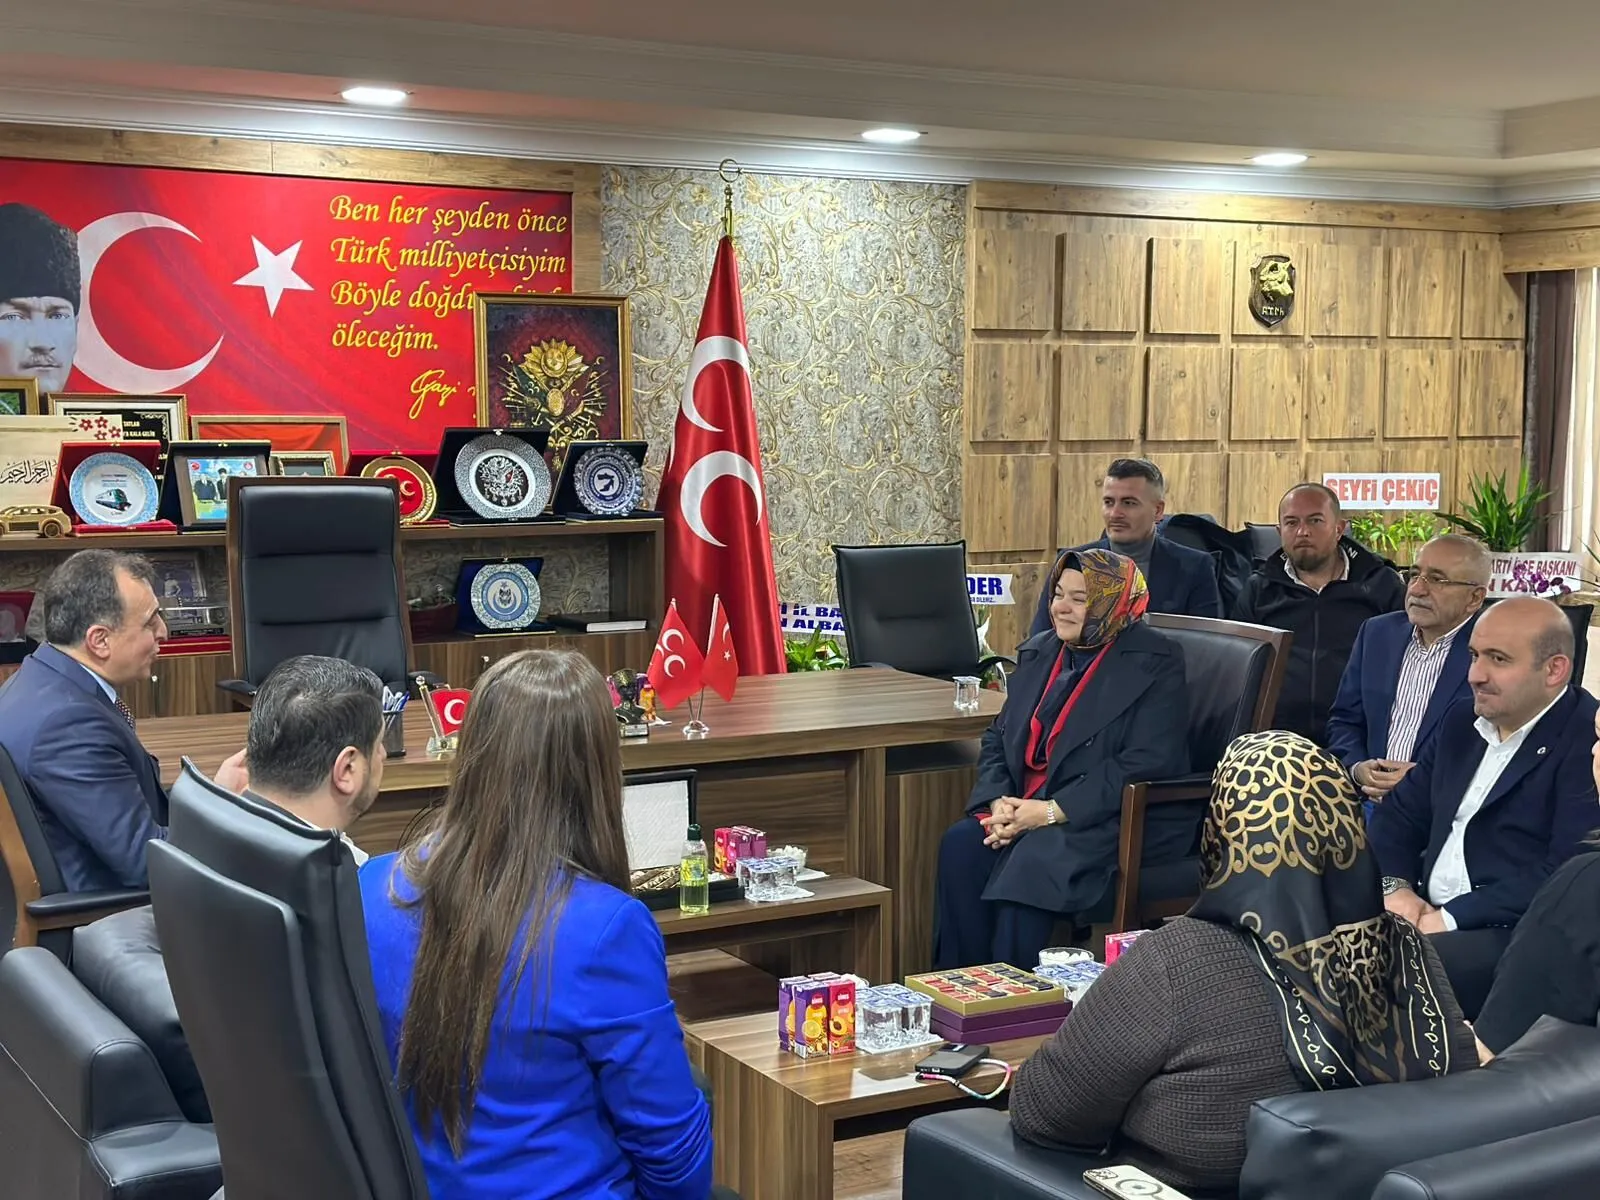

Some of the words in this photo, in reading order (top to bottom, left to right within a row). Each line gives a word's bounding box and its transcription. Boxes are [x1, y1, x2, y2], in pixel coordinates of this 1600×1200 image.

[329, 195, 380, 221] Ben
[388, 195, 428, 224] her
[432, 201, 511, 236] şeyden
[517, 208, 568, 233] önce
[330, 236, 397, 272] Türk
[399, 240, 567, 281] milliyetçisiyim
[331, 279, 402, 315] Böyle
[332, 320, 439, 358] öleceğim.
